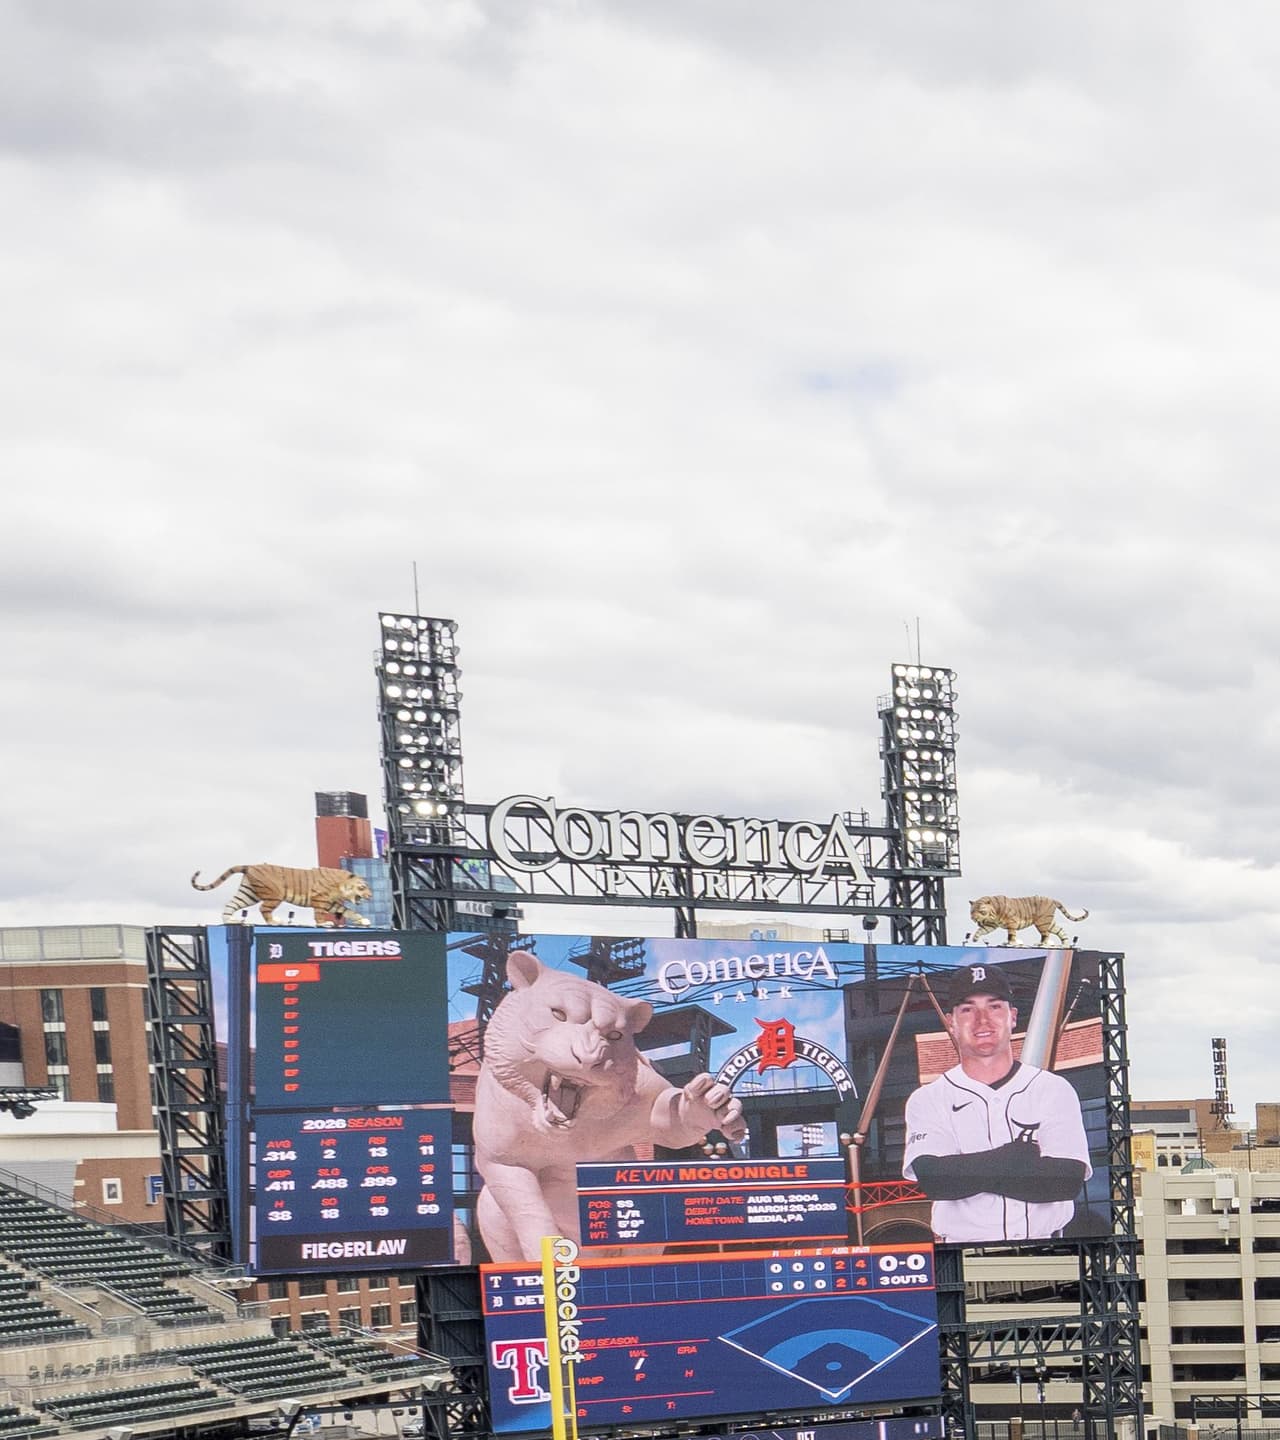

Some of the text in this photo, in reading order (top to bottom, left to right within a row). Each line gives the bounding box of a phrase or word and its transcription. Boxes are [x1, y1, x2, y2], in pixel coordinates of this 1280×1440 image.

[602, 868, 781, 901] PARK
[308, 941, 402, 957] TIGERS
[714, 987, 792, 1004] PARK
[802, 1043, 852, 1092] TIGERS
[302, 1117, 404, 1130] 2026 SEASON
[262, 1151, 297, 1161] .314
[369, 1147, 388, 1157] 13
[420, 1145, 435, 1156] 11
[615, 1165, 808, 1183] KEVIN MCGONIGLE
[264, 1181, 296, 1191] .411
[268, 1211, 293, 1221] 38
[787, 1214, 804, 1223] PA
[879, 1254, 926, 1271] 0-0
[514, 1275, 928, 1306] DET OUTS
[554, 1265, 584, 1364] Rocket
